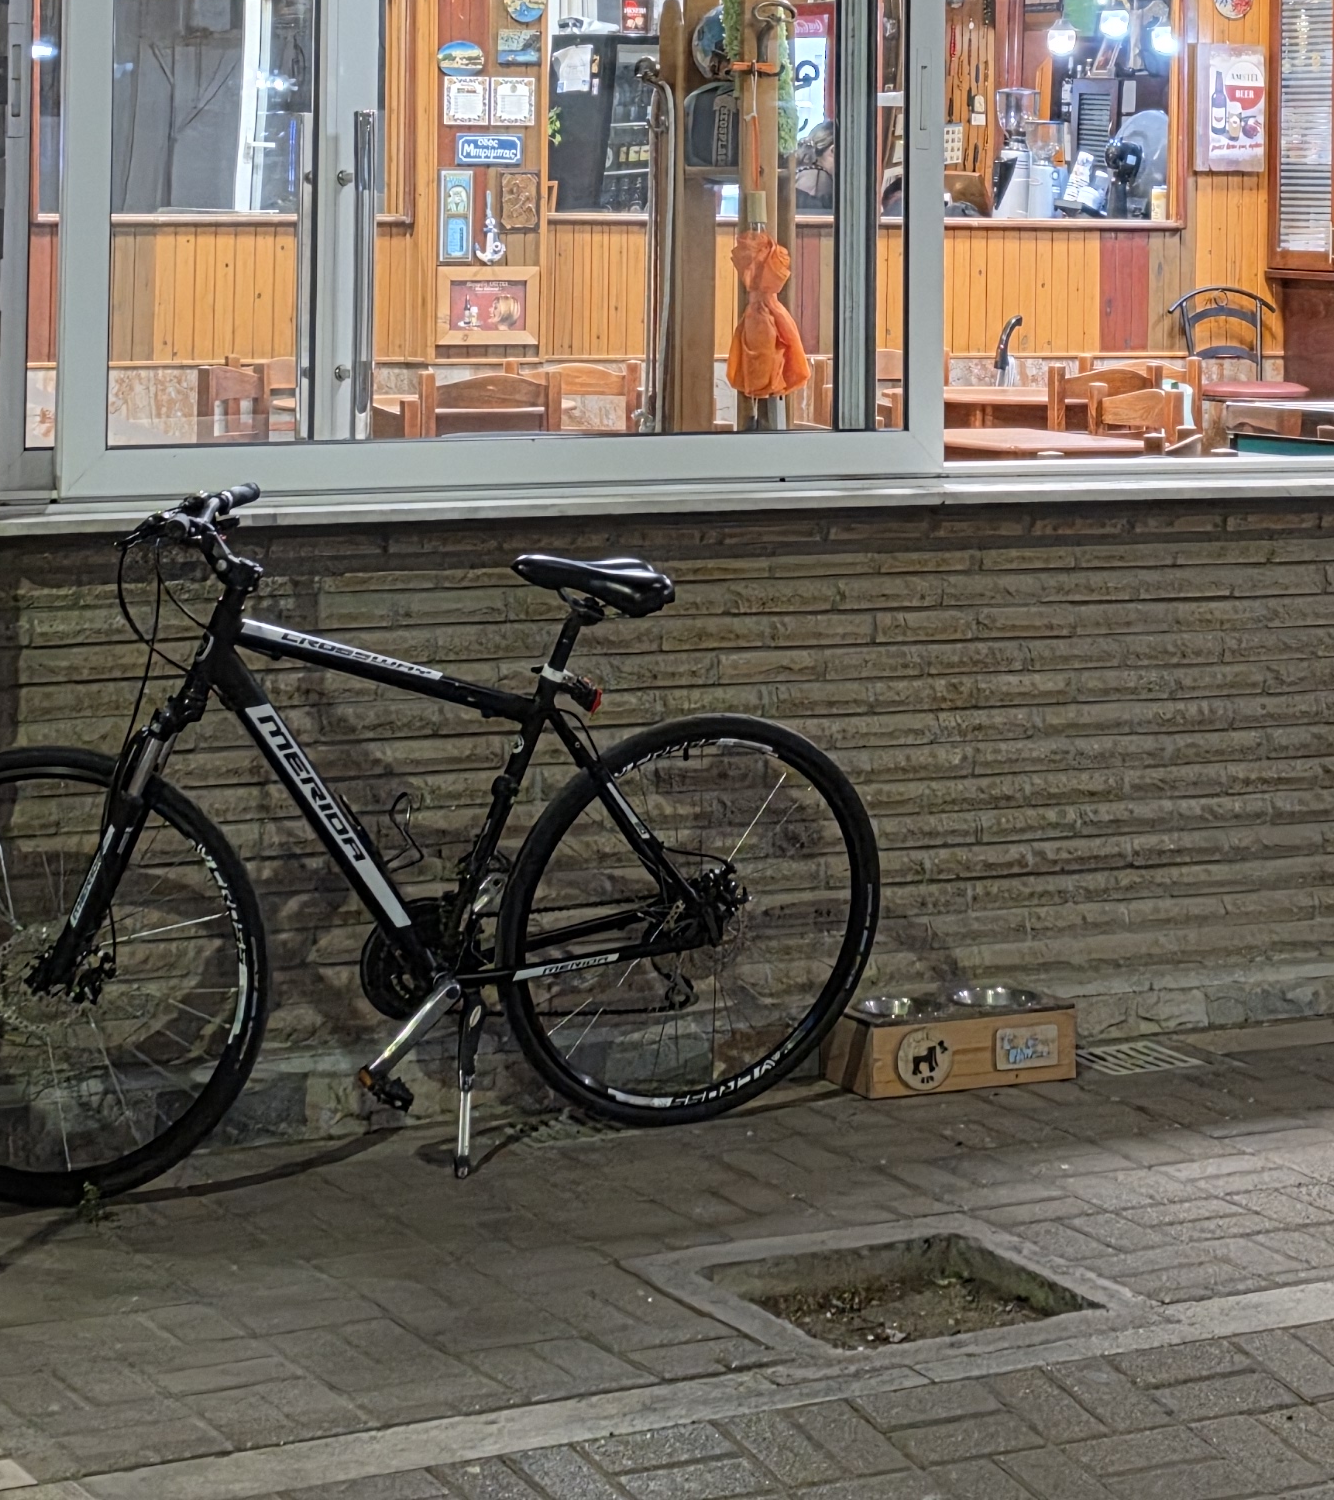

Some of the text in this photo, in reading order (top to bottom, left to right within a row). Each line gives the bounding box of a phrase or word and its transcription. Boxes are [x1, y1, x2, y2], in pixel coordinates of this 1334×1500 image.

[1231, 73, 1258, 82] AMSTEL
[1235, 90, 1254, 98] BEER
[281, 632, 431, 676] CROSSWAY
[257, 716, 365, 863] MERIDA
